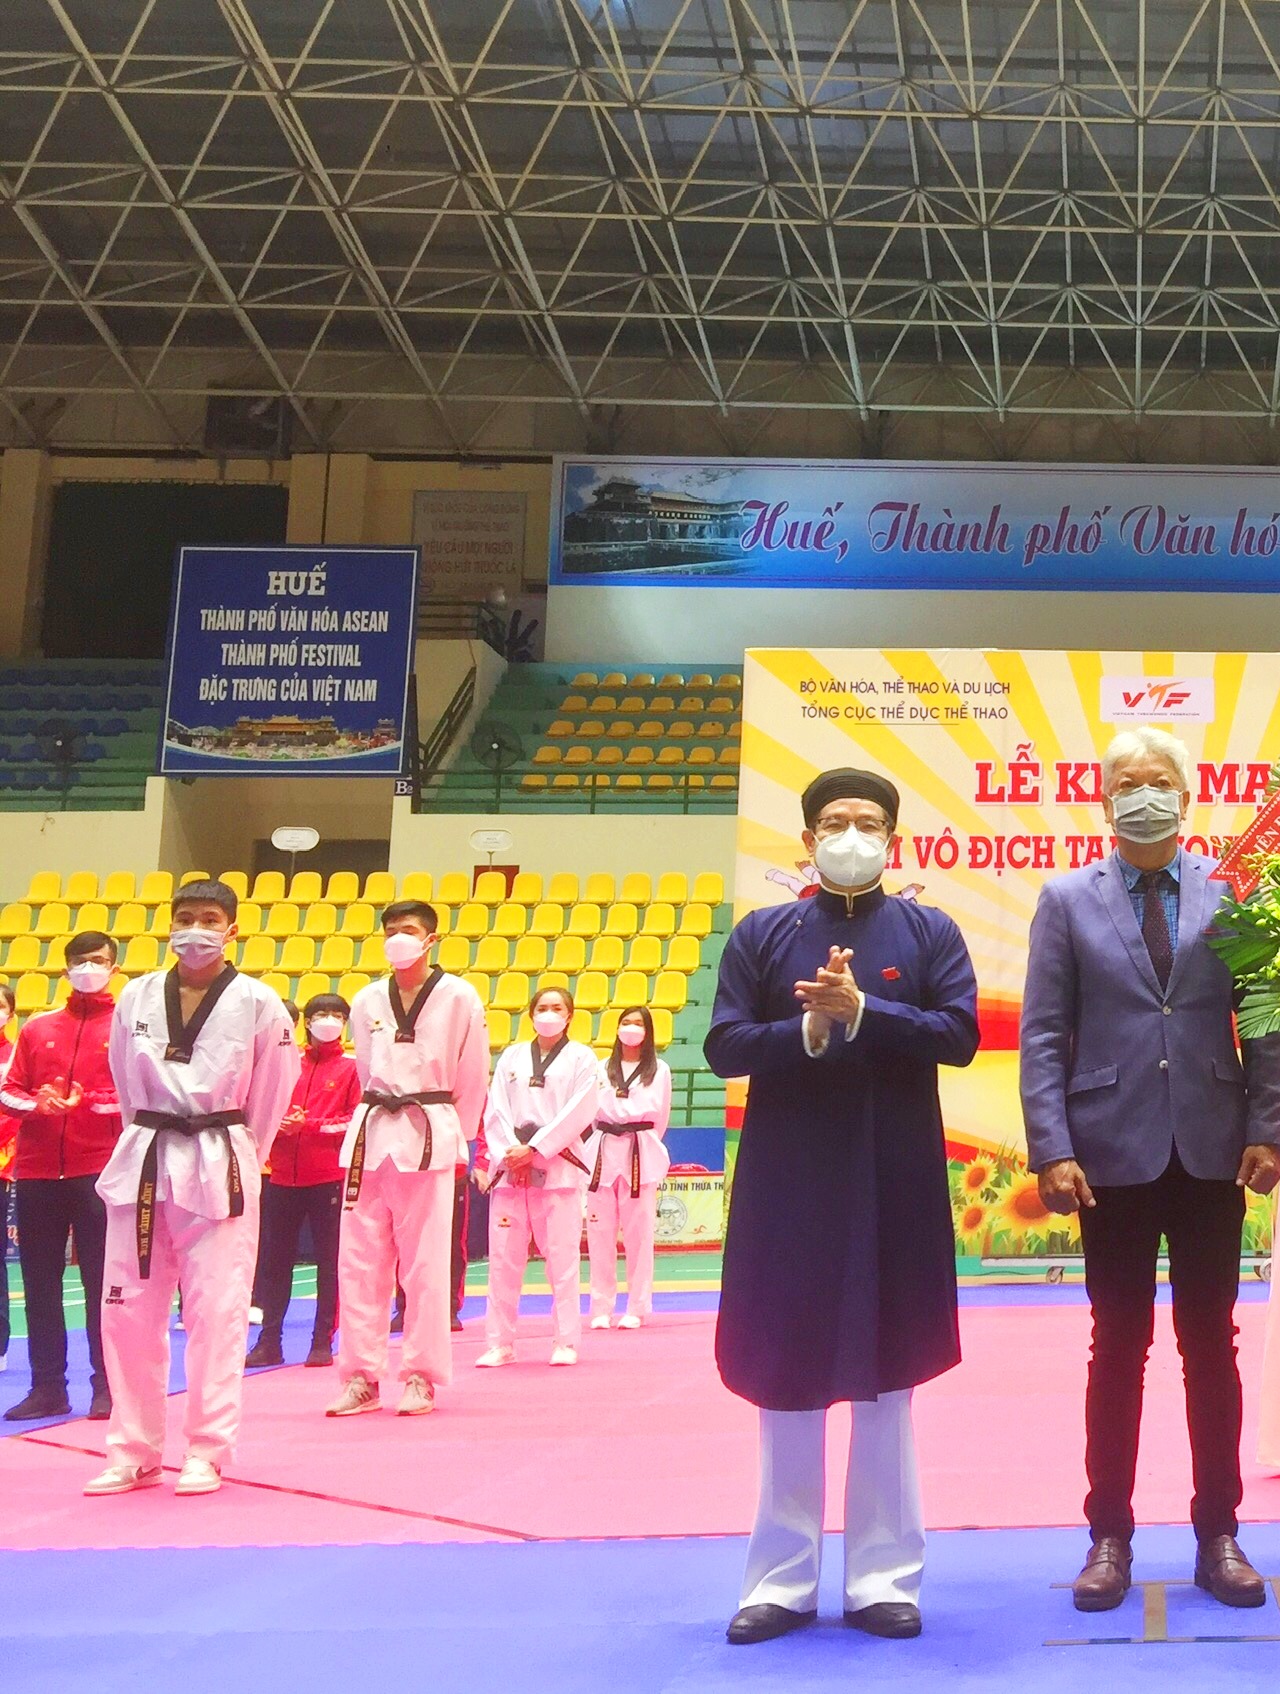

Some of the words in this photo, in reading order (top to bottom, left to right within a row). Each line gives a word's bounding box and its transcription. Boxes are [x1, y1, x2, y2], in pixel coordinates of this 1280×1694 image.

[738, 499, 849, 563] Huế,
[868, 501, 1014, 555] Thành
[1022, 503, 1111, 567] phố
[1120, 504, 1221, 558] Văn
[267, 562, 327, 596] HUẾ
[200, 605, 245, 631] THÀNH
[248, 602, 278, 631] PHỐ
[280, 606, 307, 632] VĂN
[311, 606, 339, 632] HÓA
[342, 611, 389, 633] ASEAN
[221, 639, 266, 666] THÀNH
[269, 636, 299, 666] PHỐ
[301, 644, 361, 667] FESTIVAL
[199, 674, 228, 706] ĐẶC
[232, 677, 277, 702] TRƯNG
[280, 672, 307, 702] CỦA
[312, 675, 341, 706] VIỆT
[344, 679, 378, 702] NAM
[800, 677, 817, 696] BỘ
[820, 678, 846, 694] VĂN
[850, 677, 879, 695] HÓA,
[883, 675, 904, 694] THỂ
[907, 681, 939, 694] THAO
[942, 679, 960, 694] VÀ
[963, 682, 981, 694] DU
[985, 681, 1011, 696] LỊCH
[801, 699, 840, 719] TỔNG
[844, 706, 876, 721] CỤC
[881, 700, 905, 719] THỂ
[910, 706, 941, 722] DỤC
[945, 700, 969, 719] THỂ
[973, 706, 1009, 719] THAO
[974, 742, 1042, 804] LỄ
[1197, 763, 1271, 813] MẠ
[912, 827, 959, 869] VÔ
[968, 836, 1055, 877] ĐỊCH
[1252, 830, 1279, 856] IÊN
